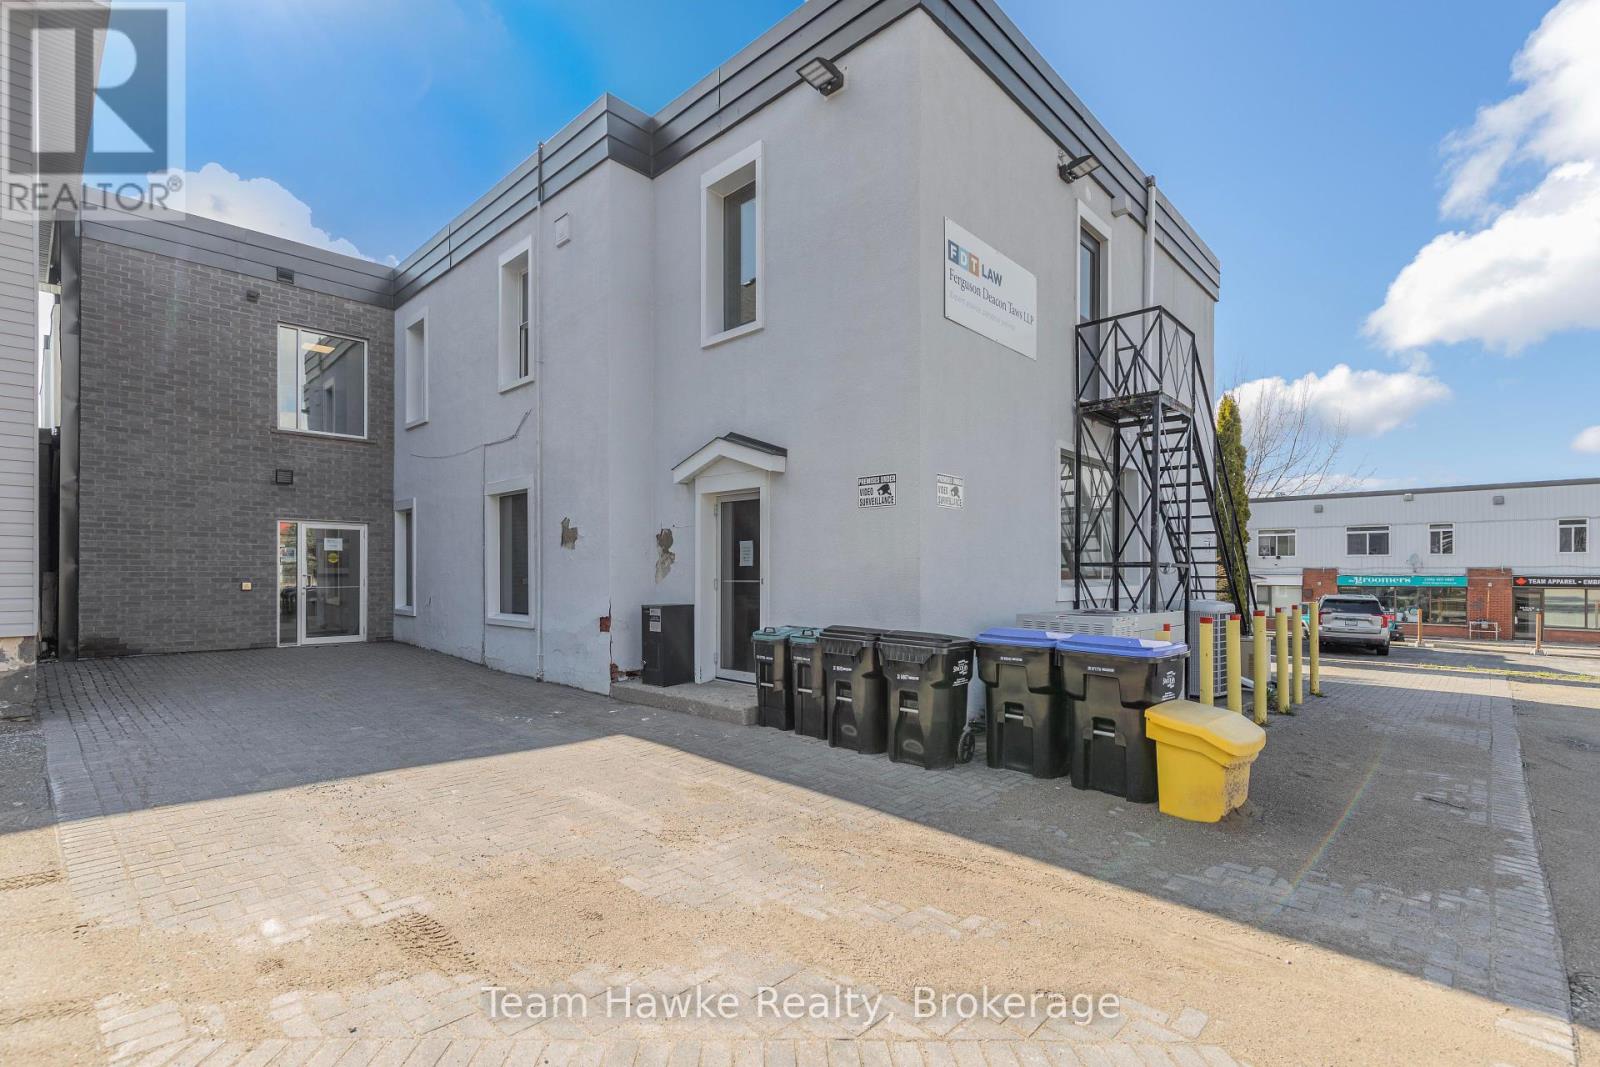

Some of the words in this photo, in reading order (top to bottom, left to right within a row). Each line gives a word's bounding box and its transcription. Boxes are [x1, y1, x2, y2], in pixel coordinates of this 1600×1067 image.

[948, 240, 979, 277] FDT
[981, 264, 1003, 287] LAW
[949, 267, 981, 297] Ferguson
[982, 287, 1007, 312] Deacon
[1008, 301, 1023, 319] Taws
[1023, 310, 1035, 325] LLP
[859, 487, 874, 497] VIDEO
[859, 496, 894, 507] SURVEILLANCE
